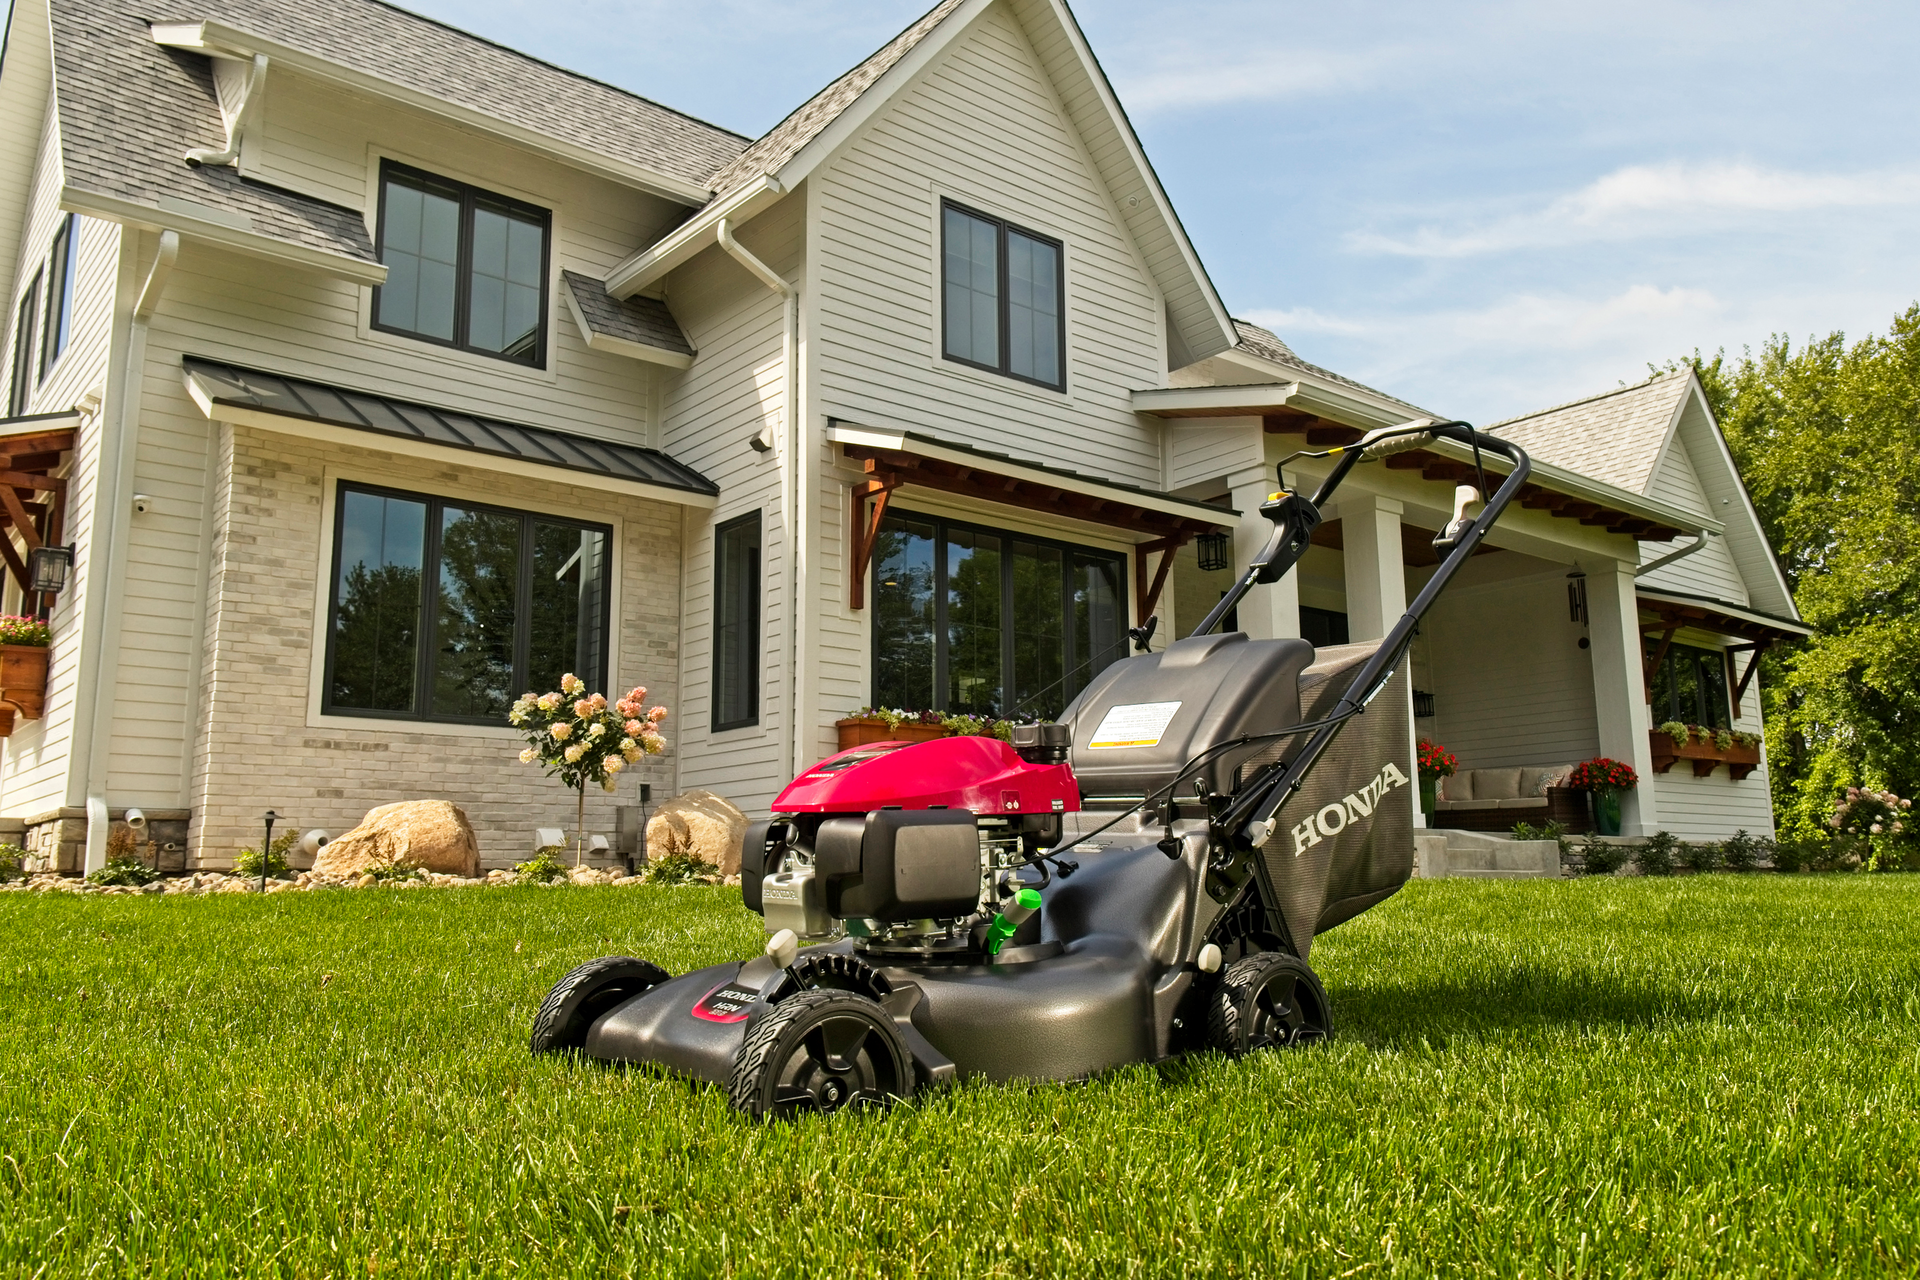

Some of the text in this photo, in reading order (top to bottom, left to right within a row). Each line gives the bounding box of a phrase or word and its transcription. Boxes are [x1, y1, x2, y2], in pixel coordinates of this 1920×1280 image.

[1291, 762, 1409, 857] HONDA
[763, 889, 798, 900] HONDA
[716, 990, 757, 1003] HOND
[712, 1002, 742, 1012] HRN
